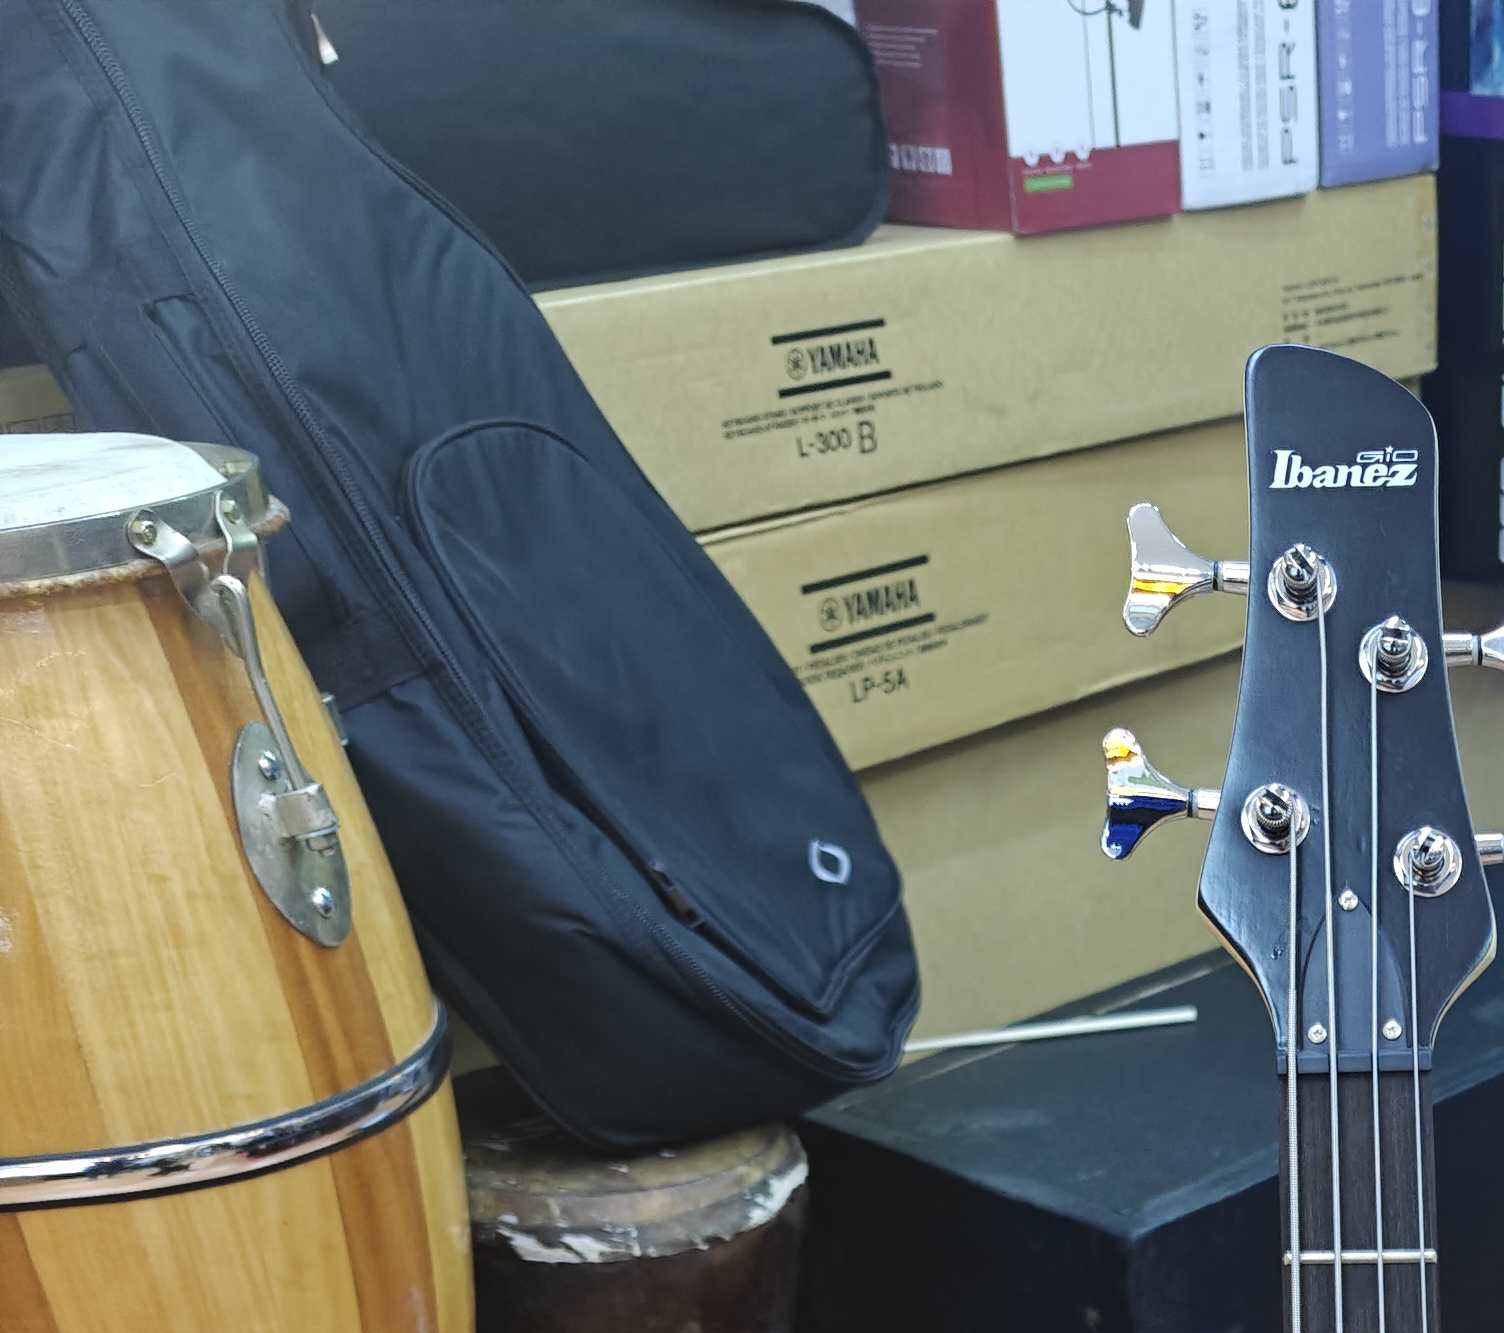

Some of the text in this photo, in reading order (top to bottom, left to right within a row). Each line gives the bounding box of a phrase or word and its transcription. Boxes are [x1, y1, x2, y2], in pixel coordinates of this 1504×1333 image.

[807, 336, 881, 375] YAMAHA
[796, 427, 852, 458] L-300
[857, 419, 879, 455] B
[1268, 449, 1419, 489] Ibanez
[842, 578, 921, 625] YAMAHA
[849, 667, 910, 704] LP-5A
